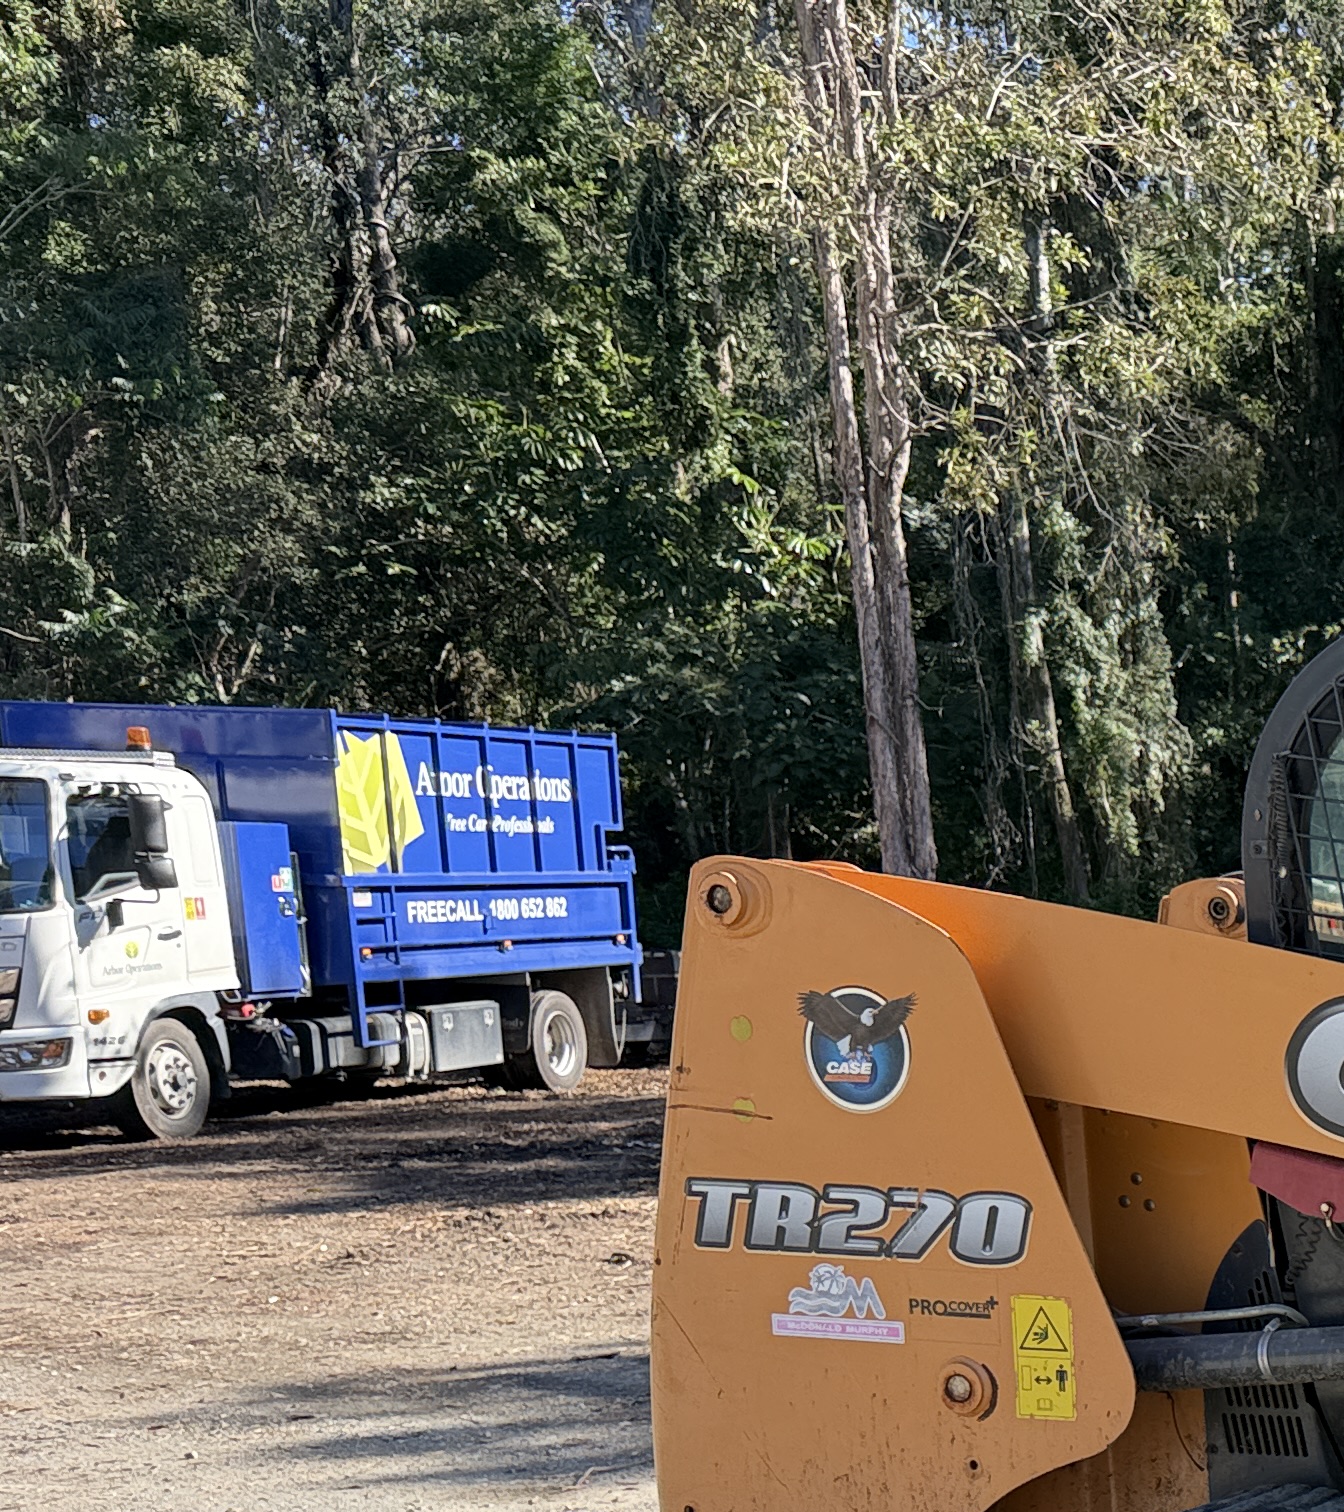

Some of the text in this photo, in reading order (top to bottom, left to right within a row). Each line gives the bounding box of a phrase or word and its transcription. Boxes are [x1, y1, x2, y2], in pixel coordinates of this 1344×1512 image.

[415, 761, 473, 798] Abor
[406, 896, 568, 923] FREECALL 1800 652 862
[826, 1061, 872, 1075] CASE
[686, 1178, 1033, 1264] TR270
[846, 1324, 890, 1336] MURPHY
